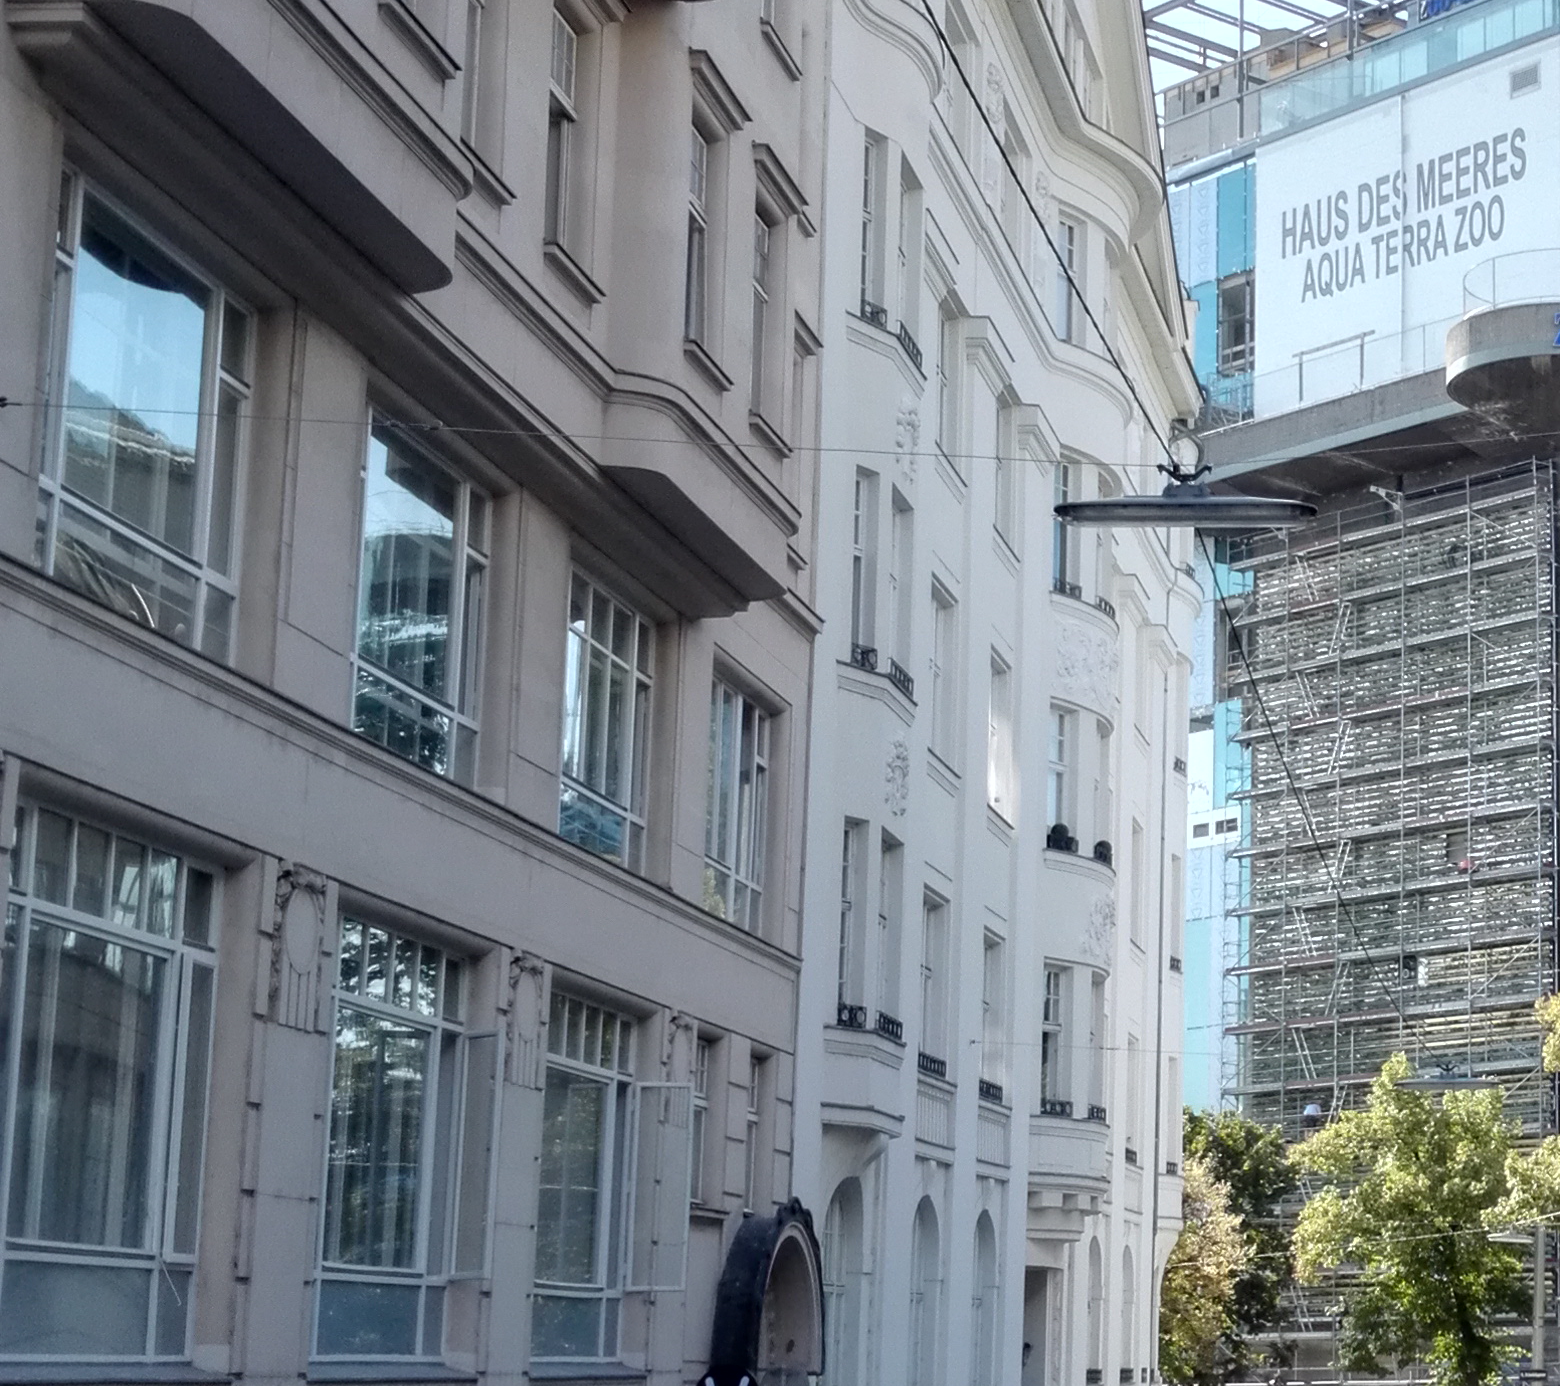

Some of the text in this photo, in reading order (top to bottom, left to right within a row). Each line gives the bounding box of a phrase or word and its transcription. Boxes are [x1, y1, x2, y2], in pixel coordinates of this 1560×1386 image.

[1280, 127, 1527, 258] HAUS DES MEERES
[1301, 195, 1506, 303] AQUA TERRA ZOO
